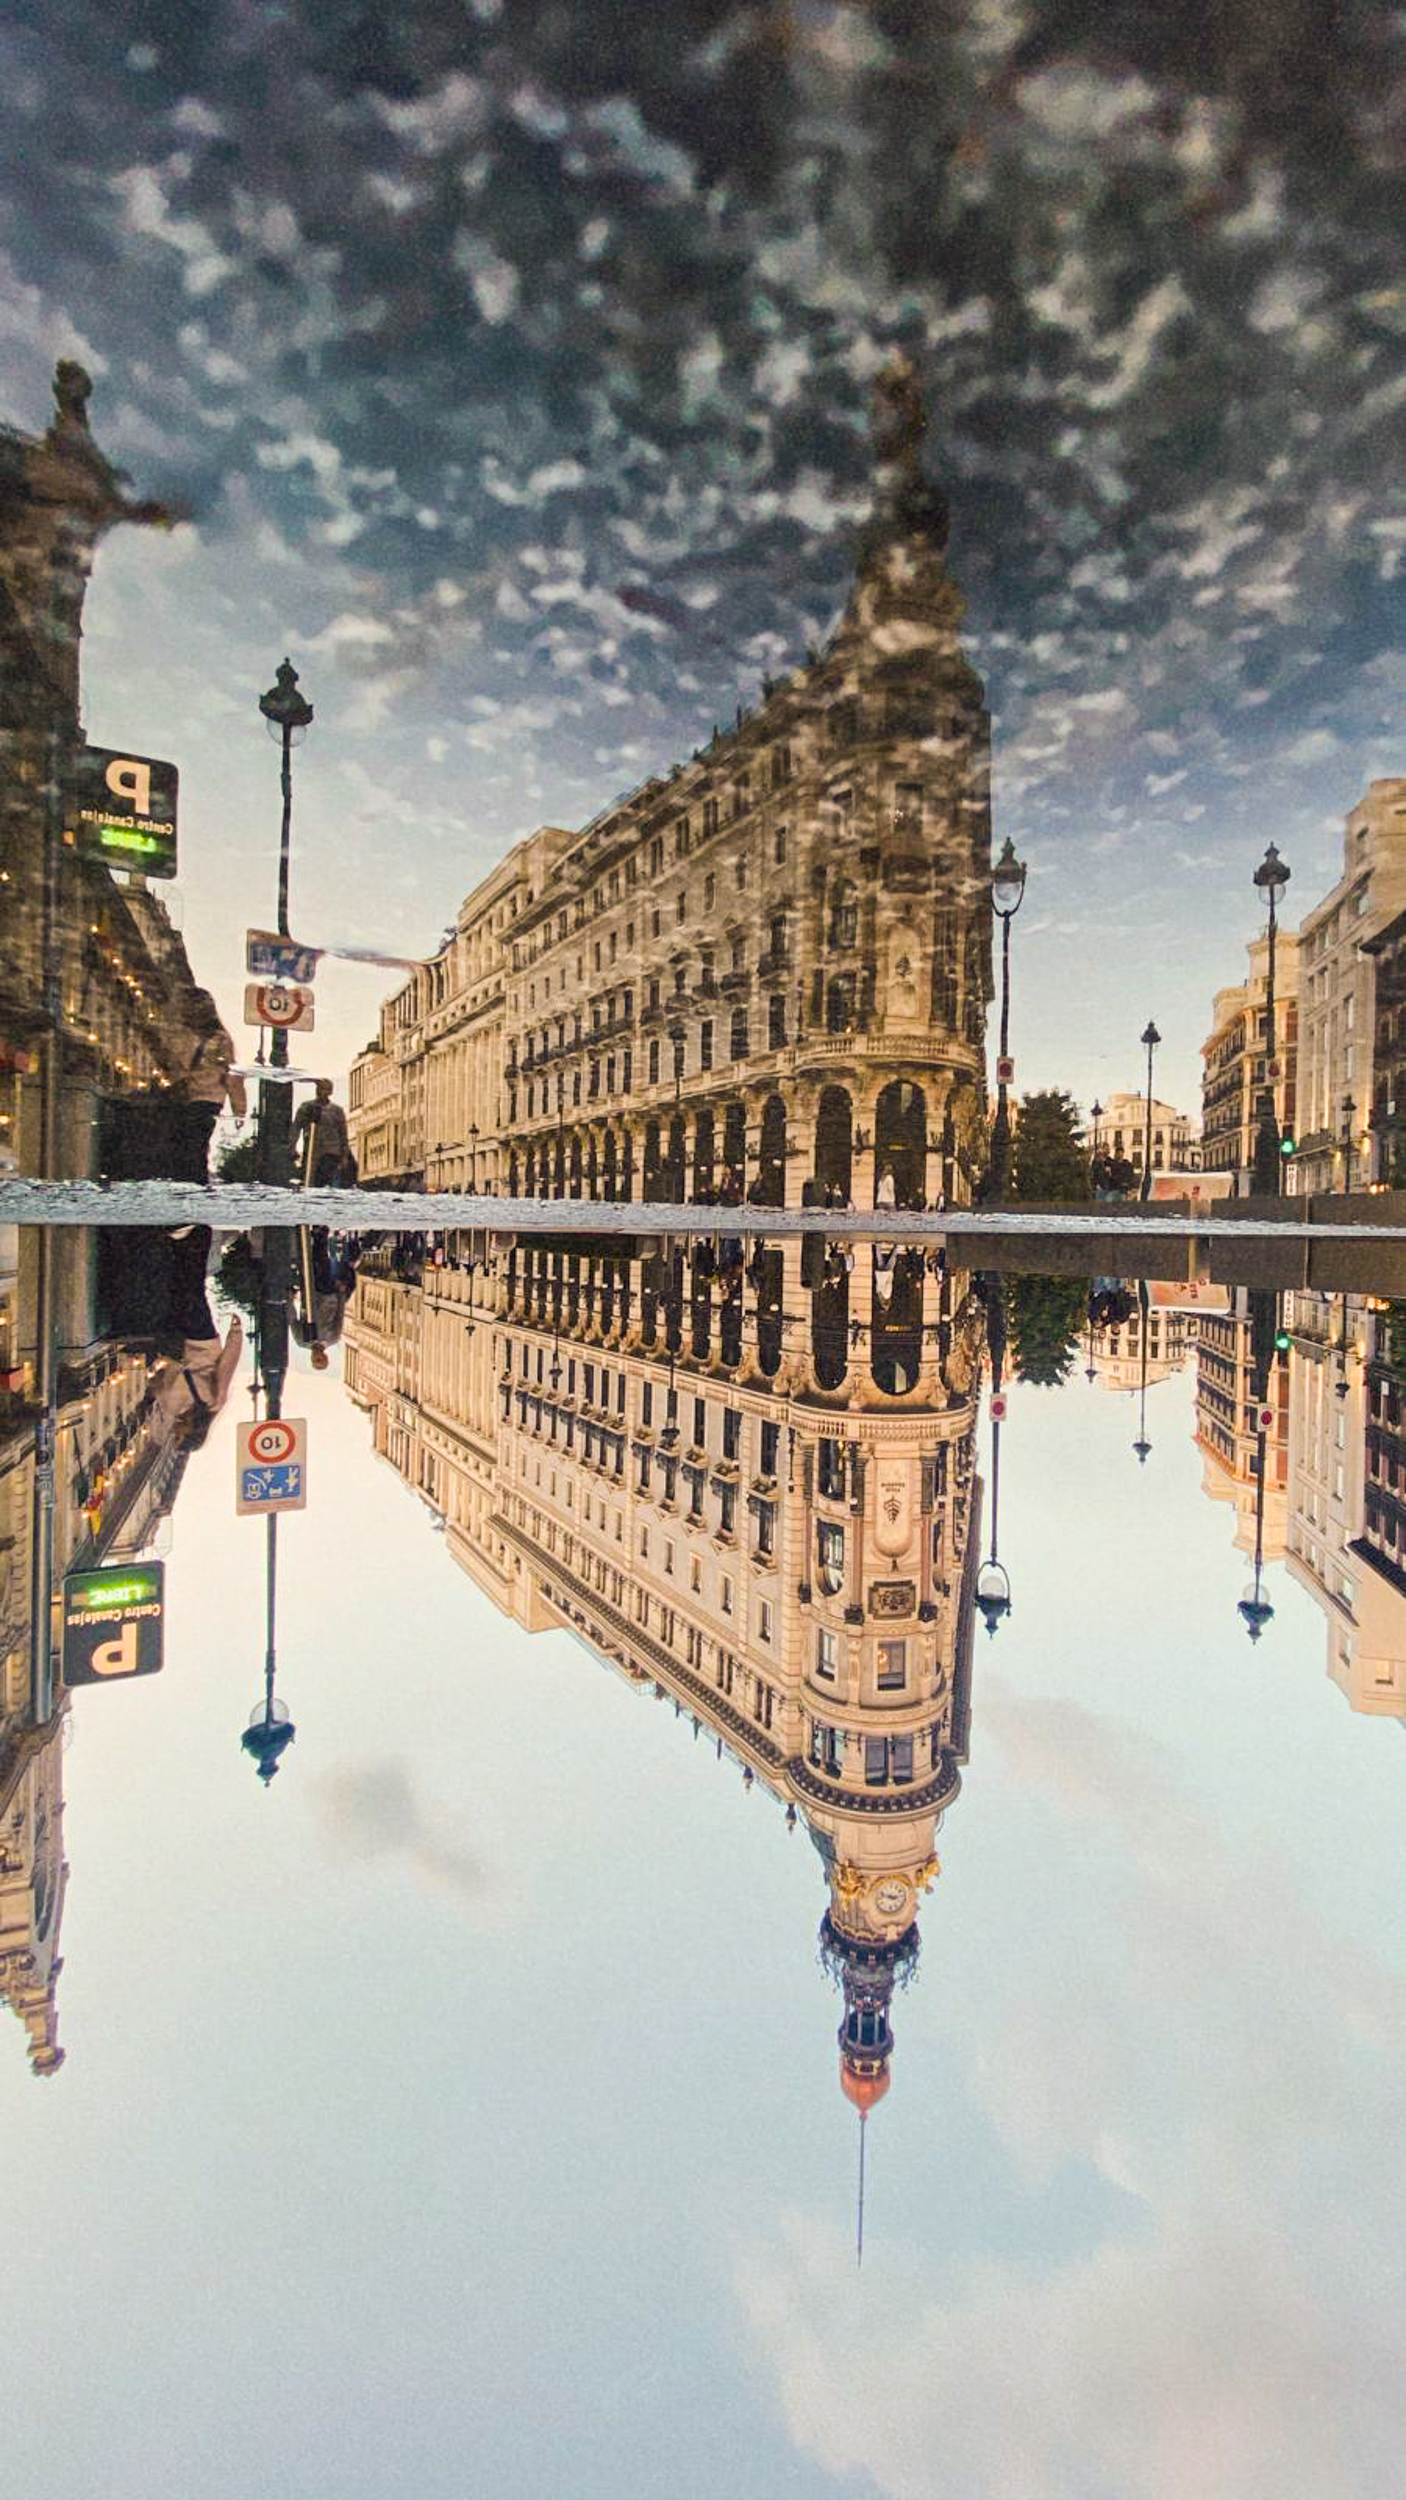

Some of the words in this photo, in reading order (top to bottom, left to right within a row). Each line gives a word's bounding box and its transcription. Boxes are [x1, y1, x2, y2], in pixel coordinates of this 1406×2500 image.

[261, 1436, 281, 1450] 10
[67, 1609, 122, 1626] Canalejas
[124, 1603, 161, 1618] Centro
[92, 1623, 137, 1675] P
